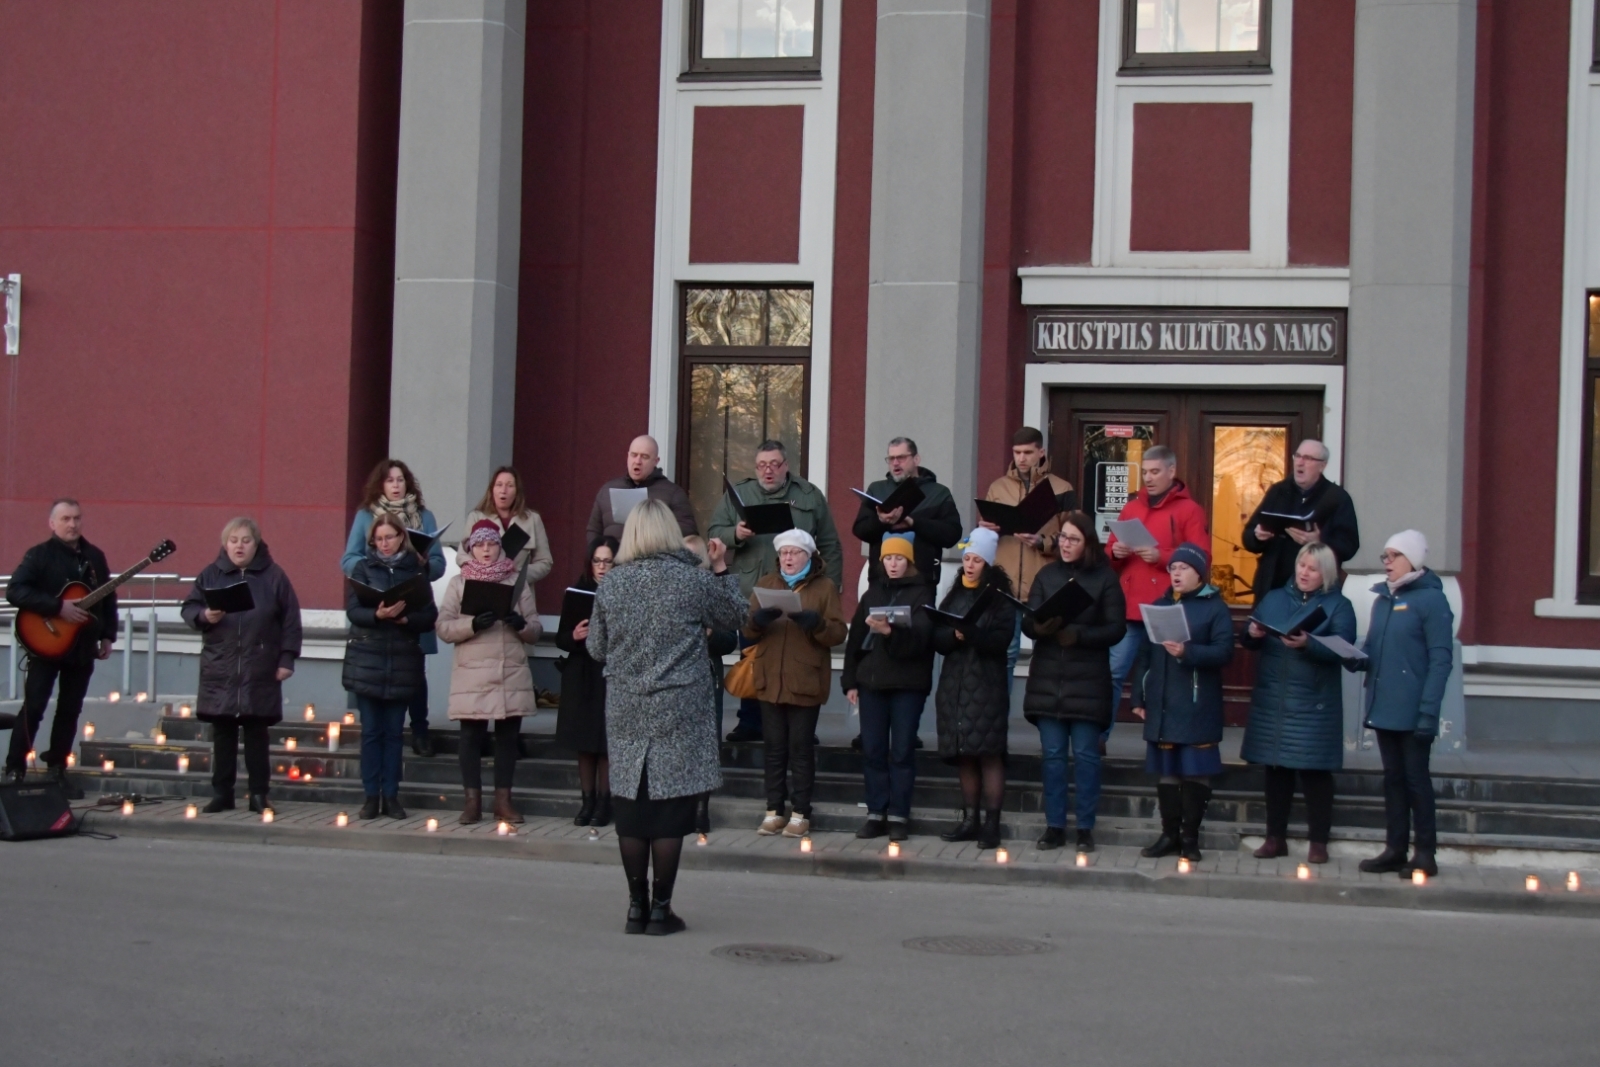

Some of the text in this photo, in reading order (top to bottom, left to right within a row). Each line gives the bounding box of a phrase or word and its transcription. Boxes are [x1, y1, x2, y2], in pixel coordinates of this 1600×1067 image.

[1037, 319, 1333, 352] KRUSTPILS KULTŪRAS NAMS
